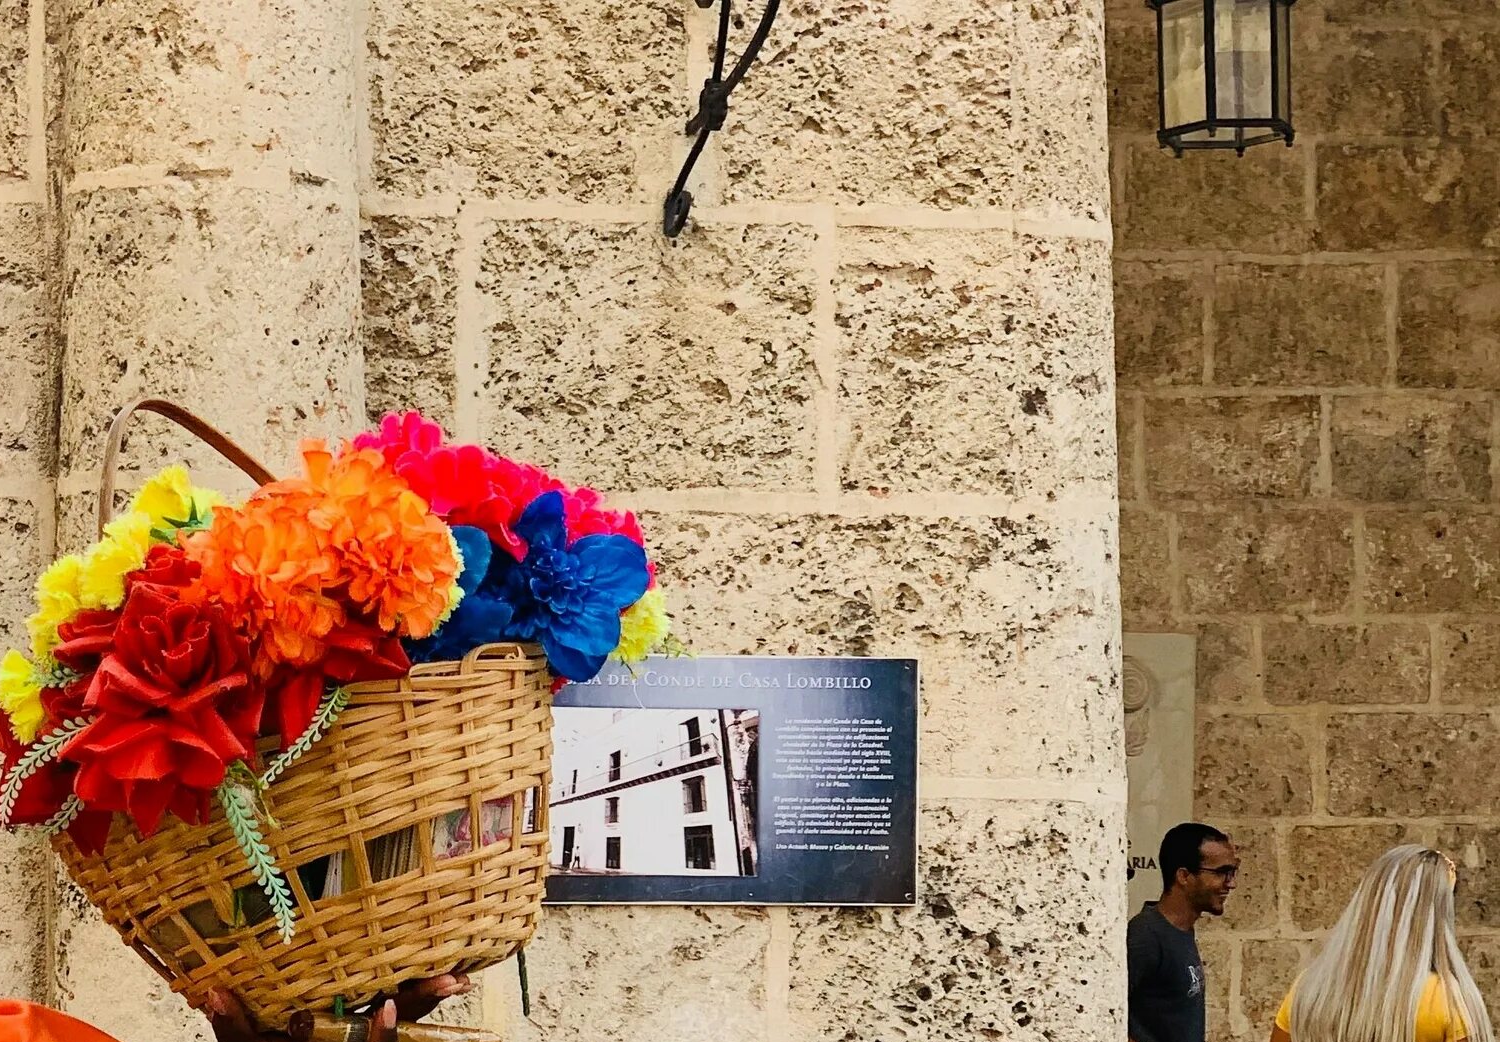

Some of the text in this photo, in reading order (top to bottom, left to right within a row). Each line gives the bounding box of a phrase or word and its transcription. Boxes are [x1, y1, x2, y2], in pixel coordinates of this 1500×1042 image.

[712, 675, 732, 687] DE
[739, 672, 780, 688] CASA
[787, 672, 872, 689] LOMBILLO
